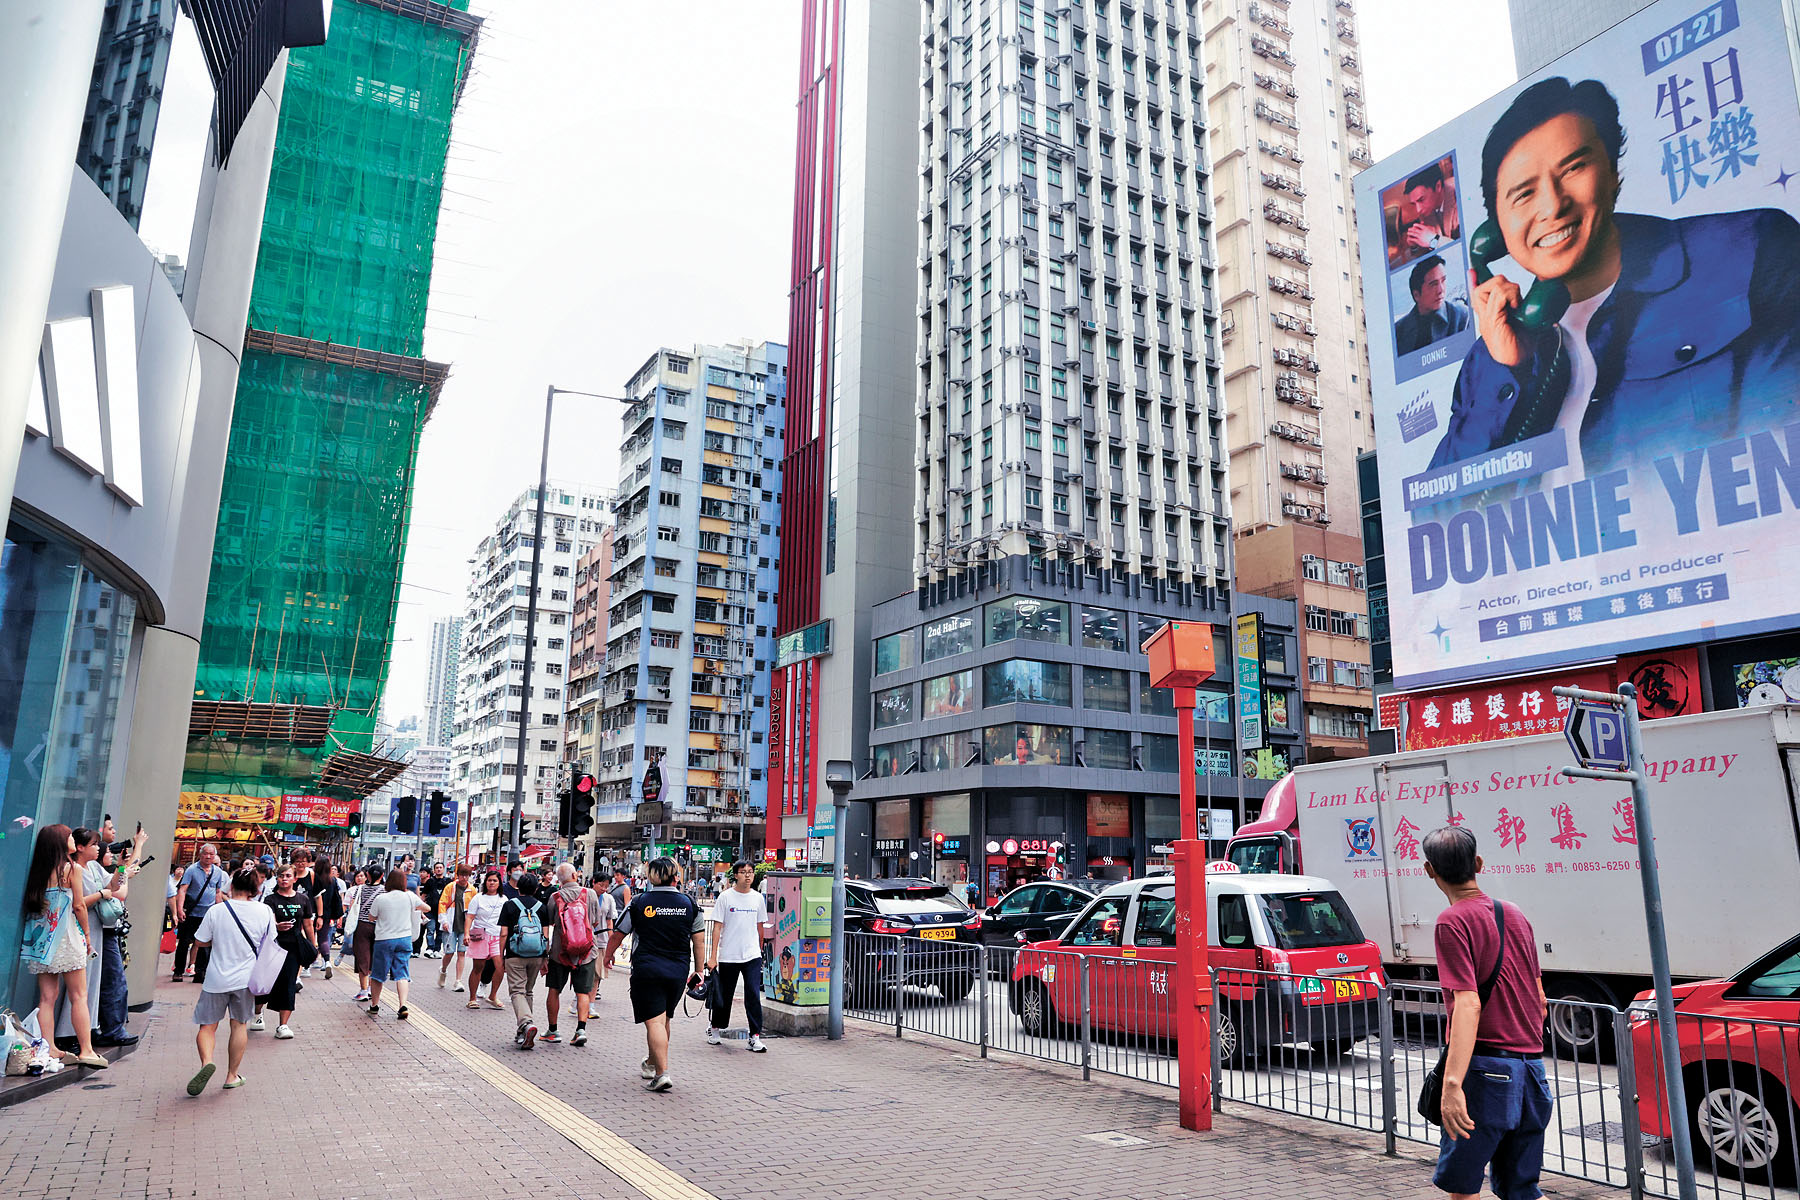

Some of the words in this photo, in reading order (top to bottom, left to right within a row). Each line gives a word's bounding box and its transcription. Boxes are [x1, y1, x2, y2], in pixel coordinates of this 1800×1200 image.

[1654, 47, 1744, 142] 生日
[1660, 106, 1760, 205] 快樂
[1421, 347, 1448, 366] DONNIE
[1408, 472, 1458, 501] Happy
[1461, 450, 1533, 486] Birthday
[1407, 469, 1637, 594] DONNIE
[1654, 424, 1800, 536] YEN
[1478, 595, 1521, 610] Actor,
[1526, 580, 1593, 601] Director,
[1600, 569, 1631, 586] and
[1638, 552, 1725, 578] Producer
[928, 626, 942, 638] 2nd
[943, 619, 958, 632] Half
[1495, 605, 1583, 635] 台前璀璨
[770, 703, 780, 759] ARGYLE
[1594, 716, 1616, 755] P
[1307, 791, 1346, 808] Lam
[1353, 786, 1389, 804] Kee
[1395, 779, 1480, 804] Express
[1020, 840, 1048, 850] 881
[1213, 863, 1237, 872] TAXI
[1514, 863, 1536, 873] 9536
[1572, 861, 1630, 872] 00853-6250
[922, 931, 934, 939] CC
[935, 930, 955, 939] 9394
